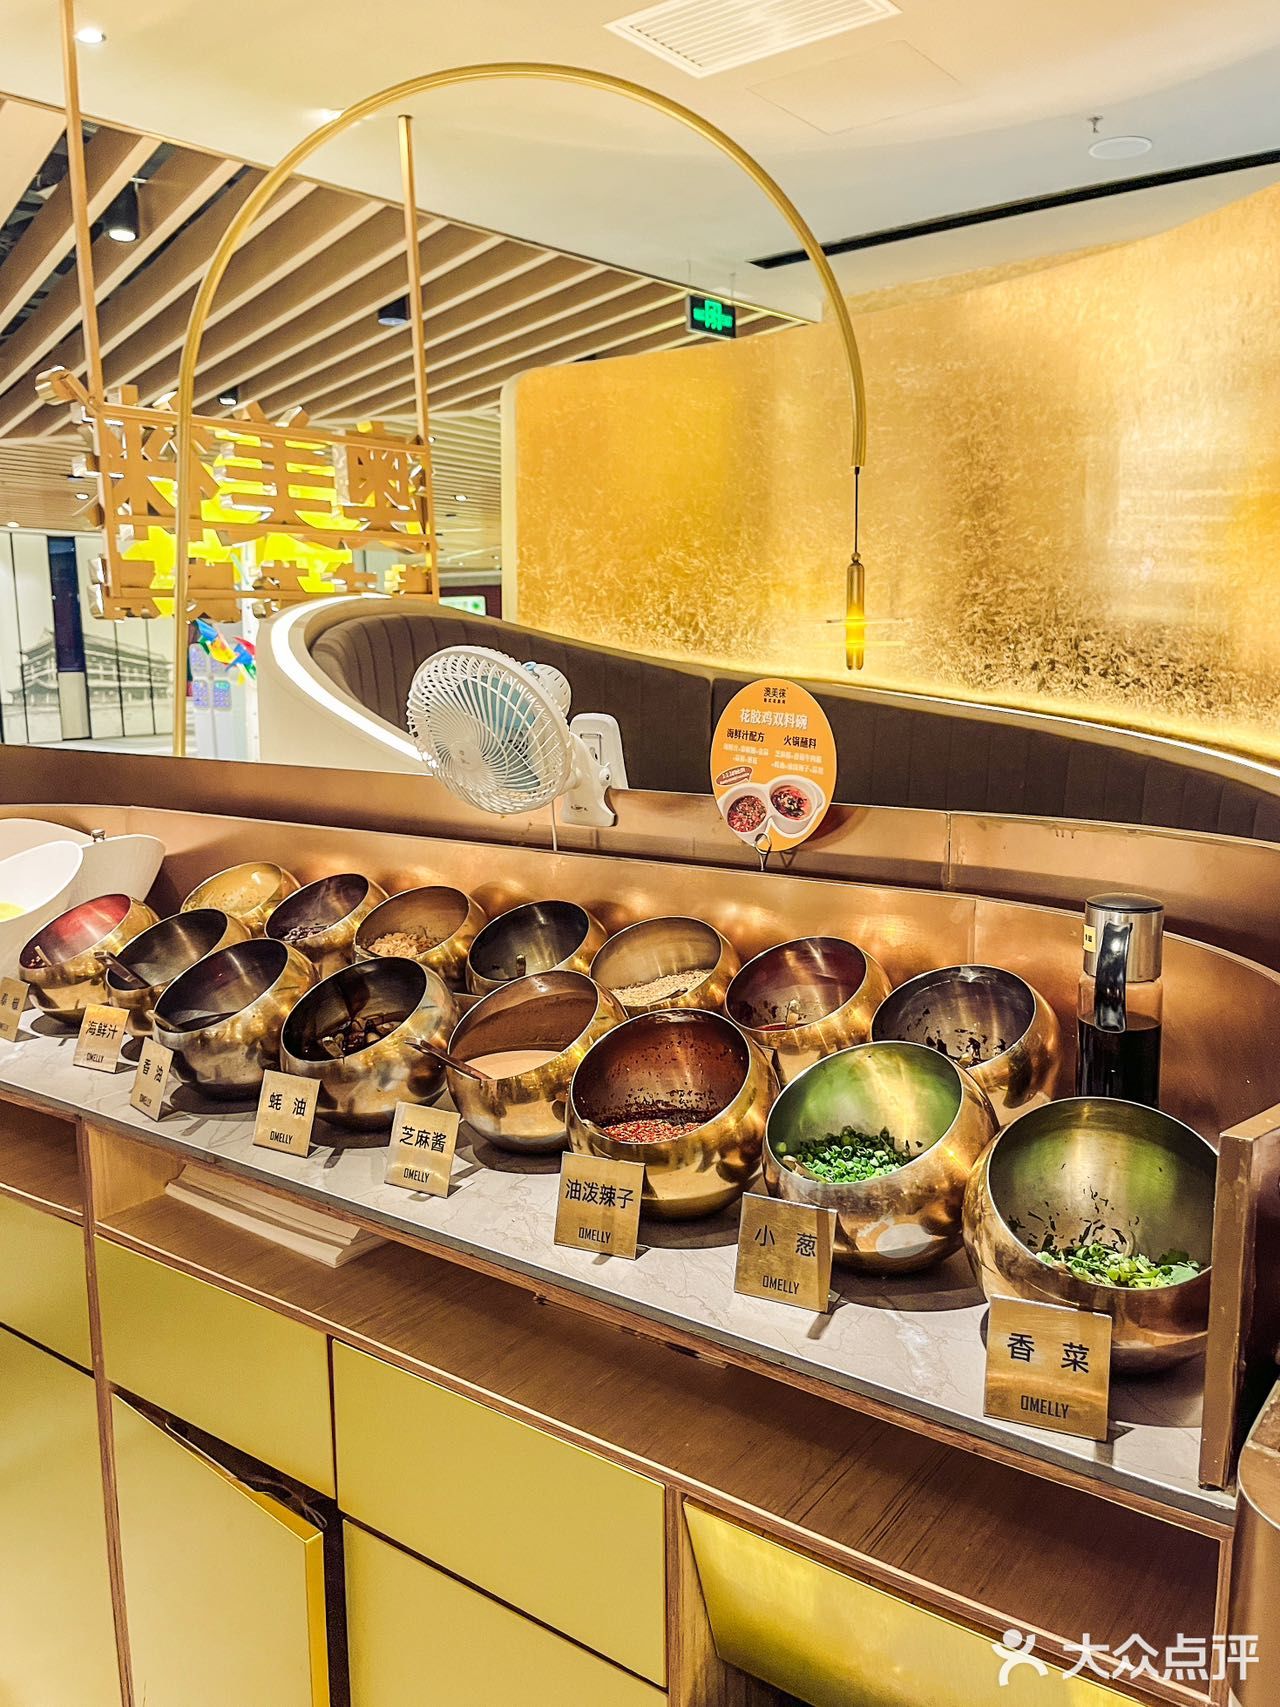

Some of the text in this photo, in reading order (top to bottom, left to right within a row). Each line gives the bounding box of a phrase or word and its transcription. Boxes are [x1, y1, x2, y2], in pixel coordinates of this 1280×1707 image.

[740, 708, 809, 730] 花胶鸡双料碗
[727, 728, 765, 743] 海鲜汁配方
[783, 735, 817, 750] 火锅蘸料
[85, 1020, 118, 1039] 海鲜汁
[268, 1092, 307, 1117] 蚝油
[269, 1130, 293, 1145] OMELLY
[399, 1125, 447, 1153] 芝麻酱
[403, 1167, 430, 1184] OMELLY
[565, 1178, 634, 1209] 油泼辣子
[578, 1227, 611, 1244] OMELLY
[754, 1224, 818, 1258] 小葱
[762, 1275, 799, 1295] OMELLY
[1007, 1332, 1090, 1374] 香菜
[1020, 1394, 1069, 1419] OMELLY
